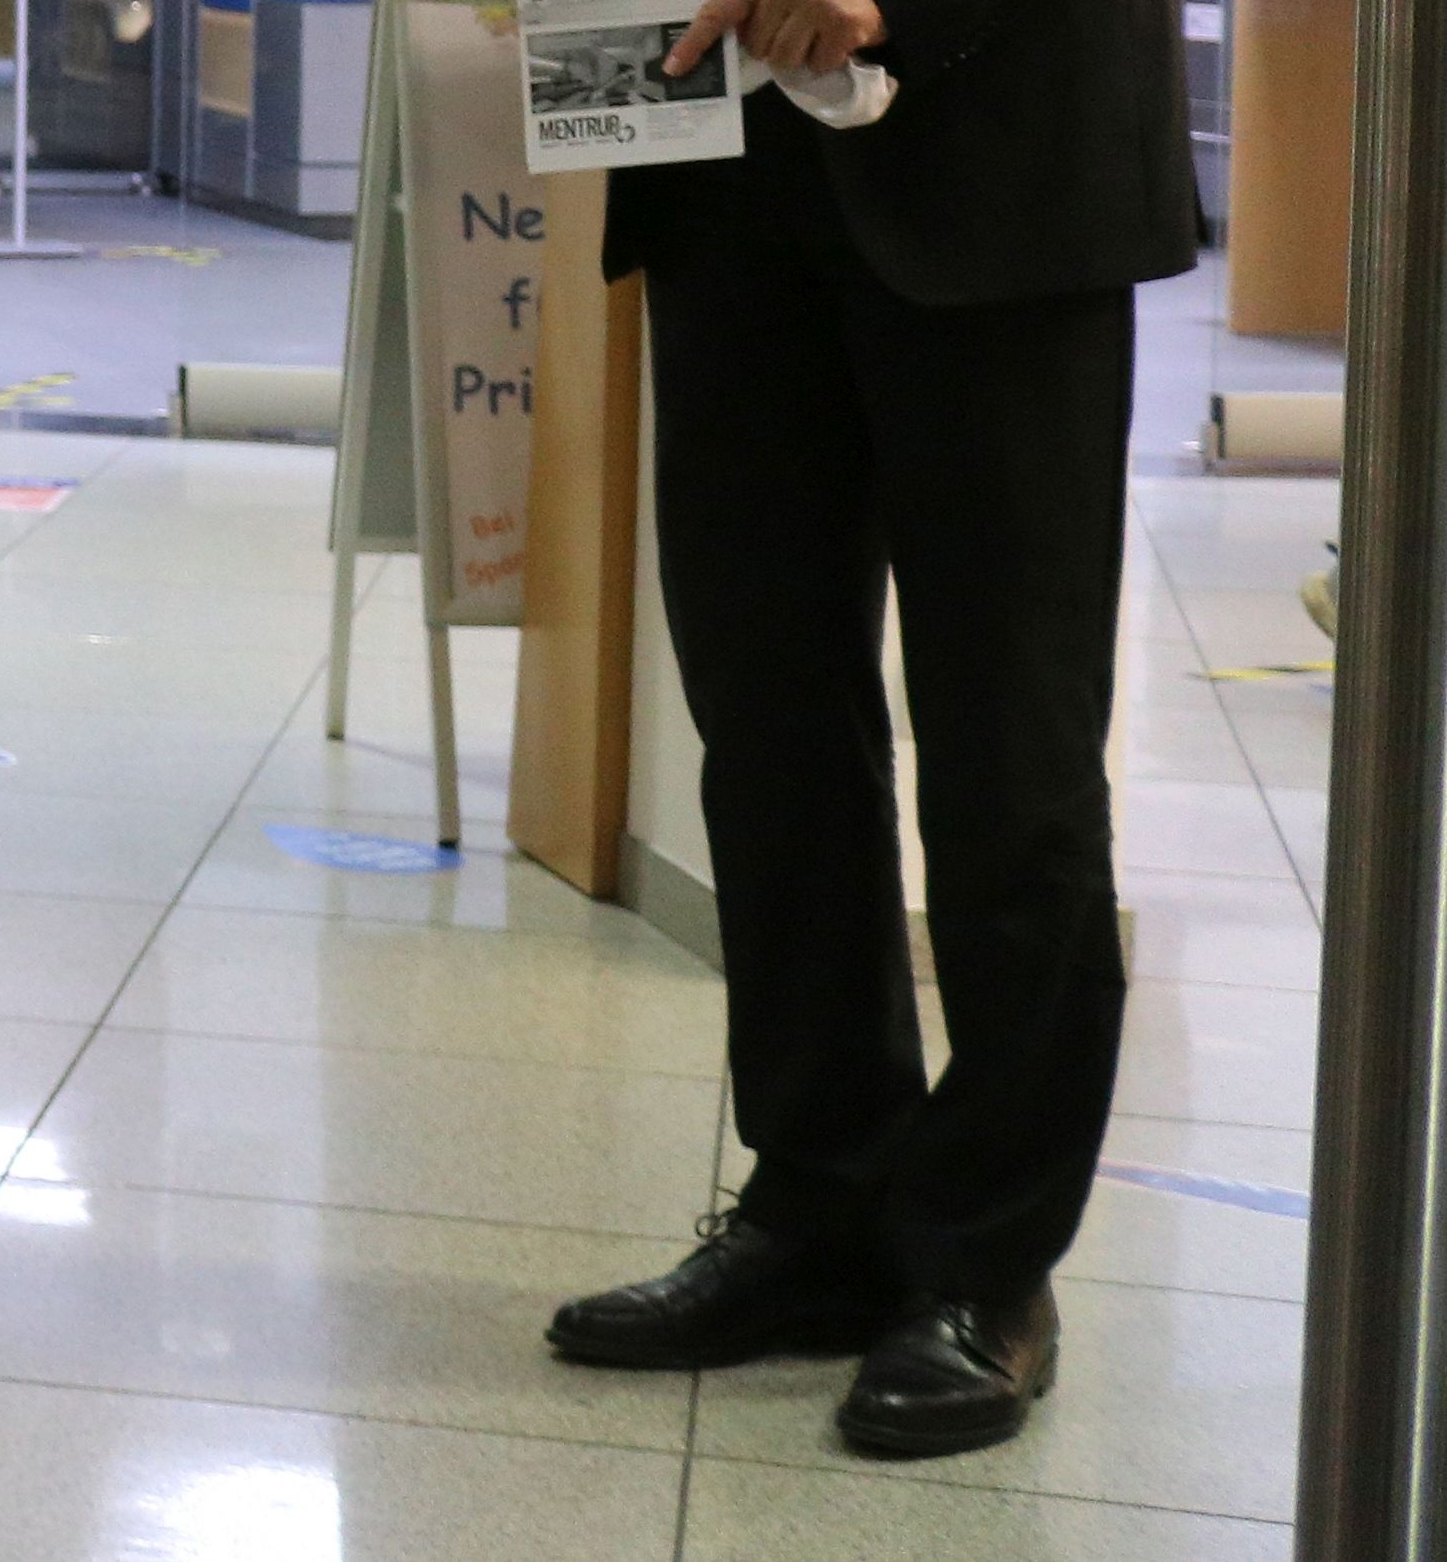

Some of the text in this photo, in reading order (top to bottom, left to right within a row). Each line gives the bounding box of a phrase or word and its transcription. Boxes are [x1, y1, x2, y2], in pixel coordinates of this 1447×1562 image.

[461, 190, 545, 242] Ne
[502, 276, 541, 330] f
[453, 363, 534, 415] Pri
